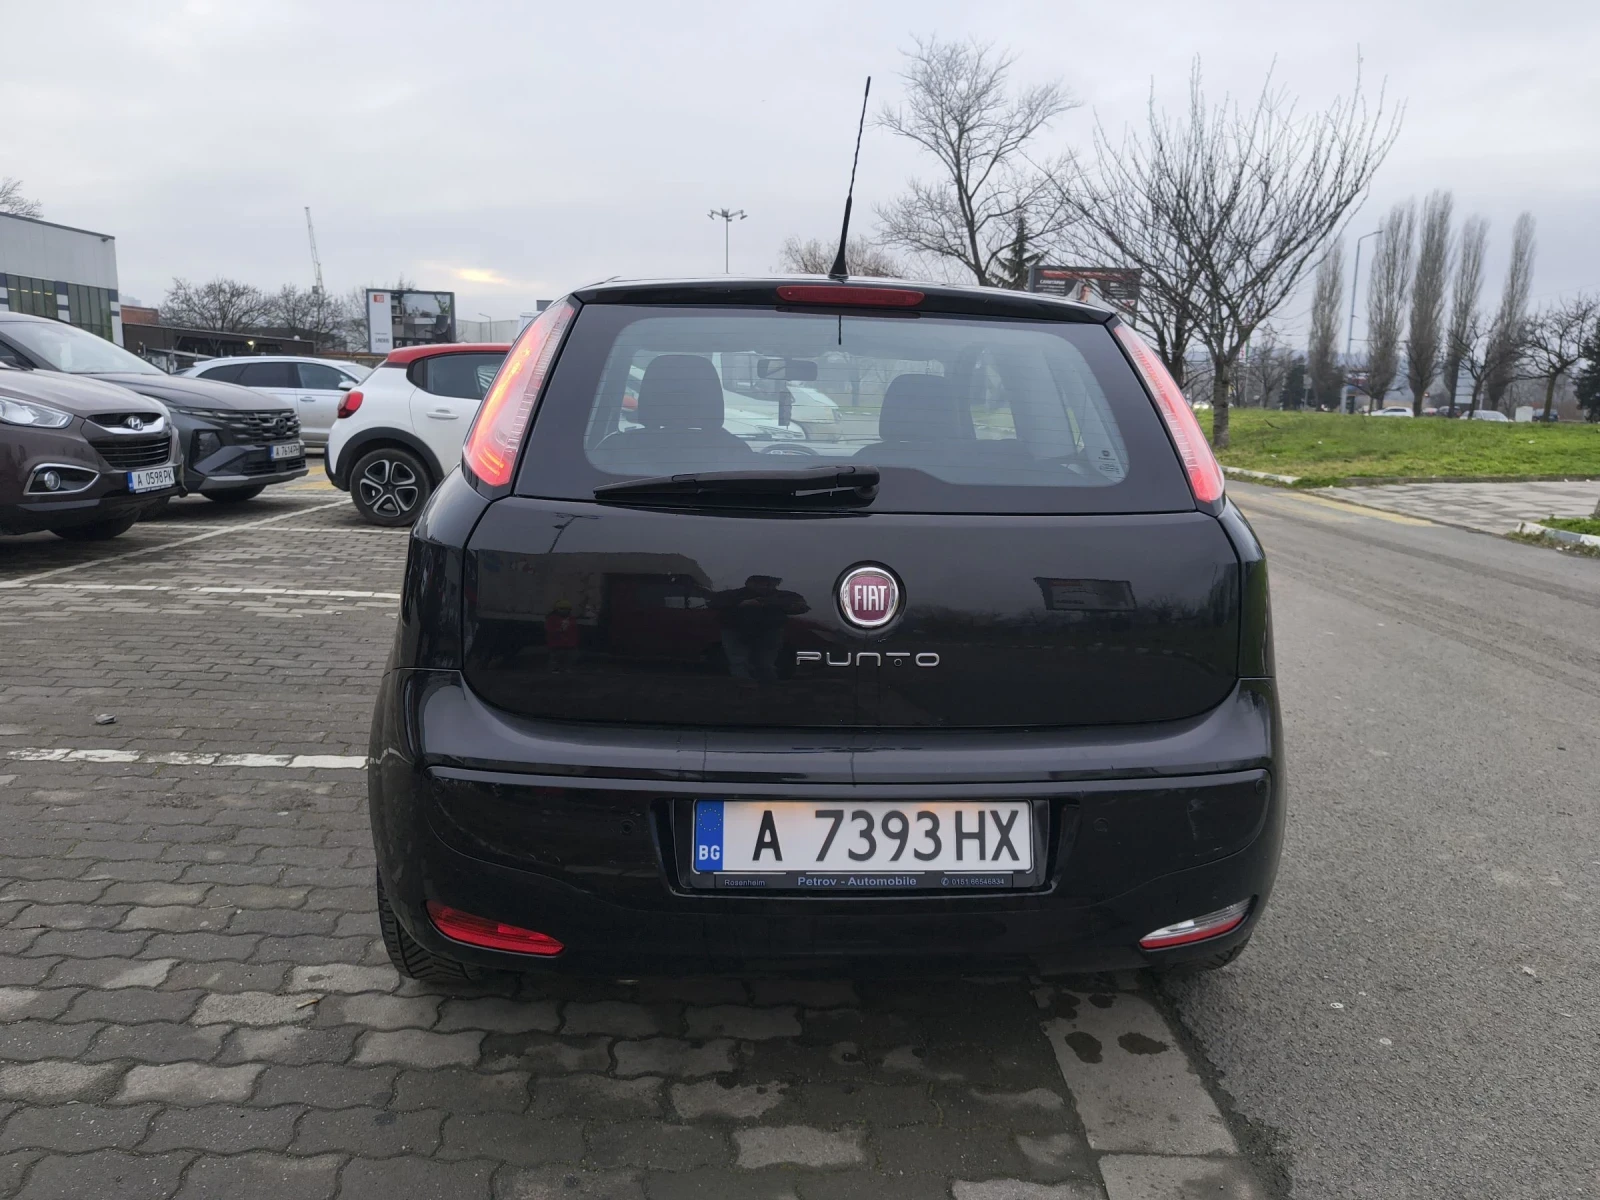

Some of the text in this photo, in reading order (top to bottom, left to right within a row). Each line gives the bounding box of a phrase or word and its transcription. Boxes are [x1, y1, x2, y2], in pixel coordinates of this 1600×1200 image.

[138, 474, 143, 487] A
[854, 585, 887, 611] FIAT
[796, 651, 940, 667] PUNTO
[752, 810, 783, 862] A
[699, 845, 720, 860] BG
[797, 876, 837, 886] Petrov
[847, 876, 917, 886] Automobile
